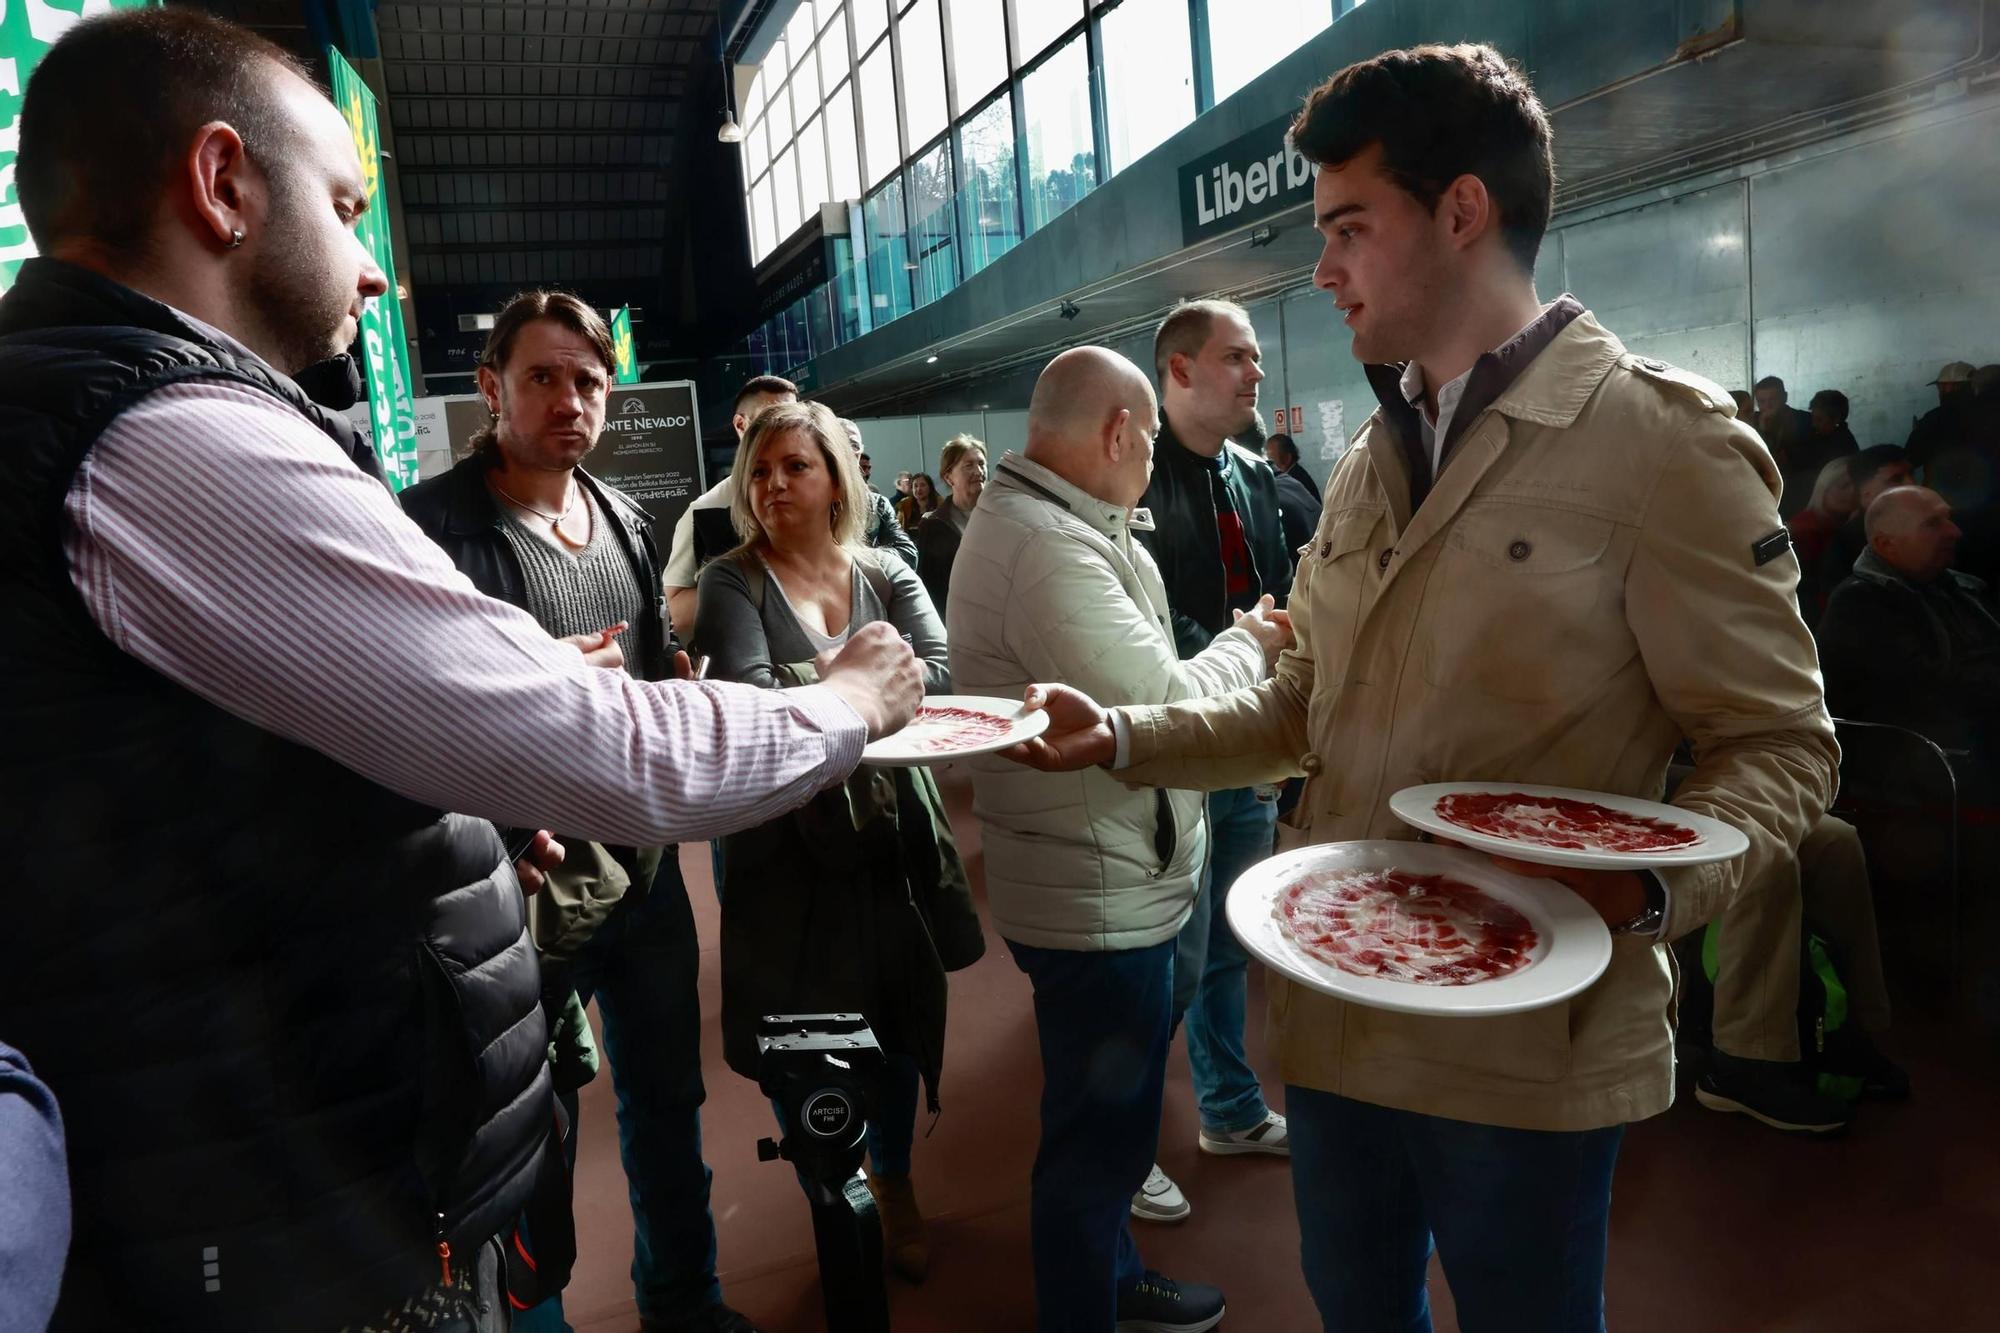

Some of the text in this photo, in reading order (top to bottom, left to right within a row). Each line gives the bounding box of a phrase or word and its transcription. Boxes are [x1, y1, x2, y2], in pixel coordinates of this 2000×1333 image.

[1195, 141, 1319, 226] Liberb
[633, 416, 687, 431] NEVADO
[639, 479, 658, 487] Bellota
[679, 476, 692, 484] 2018
[643, 472, 665, 480] Serrano
[812, 1106, 846, 1116] ARTCISE
